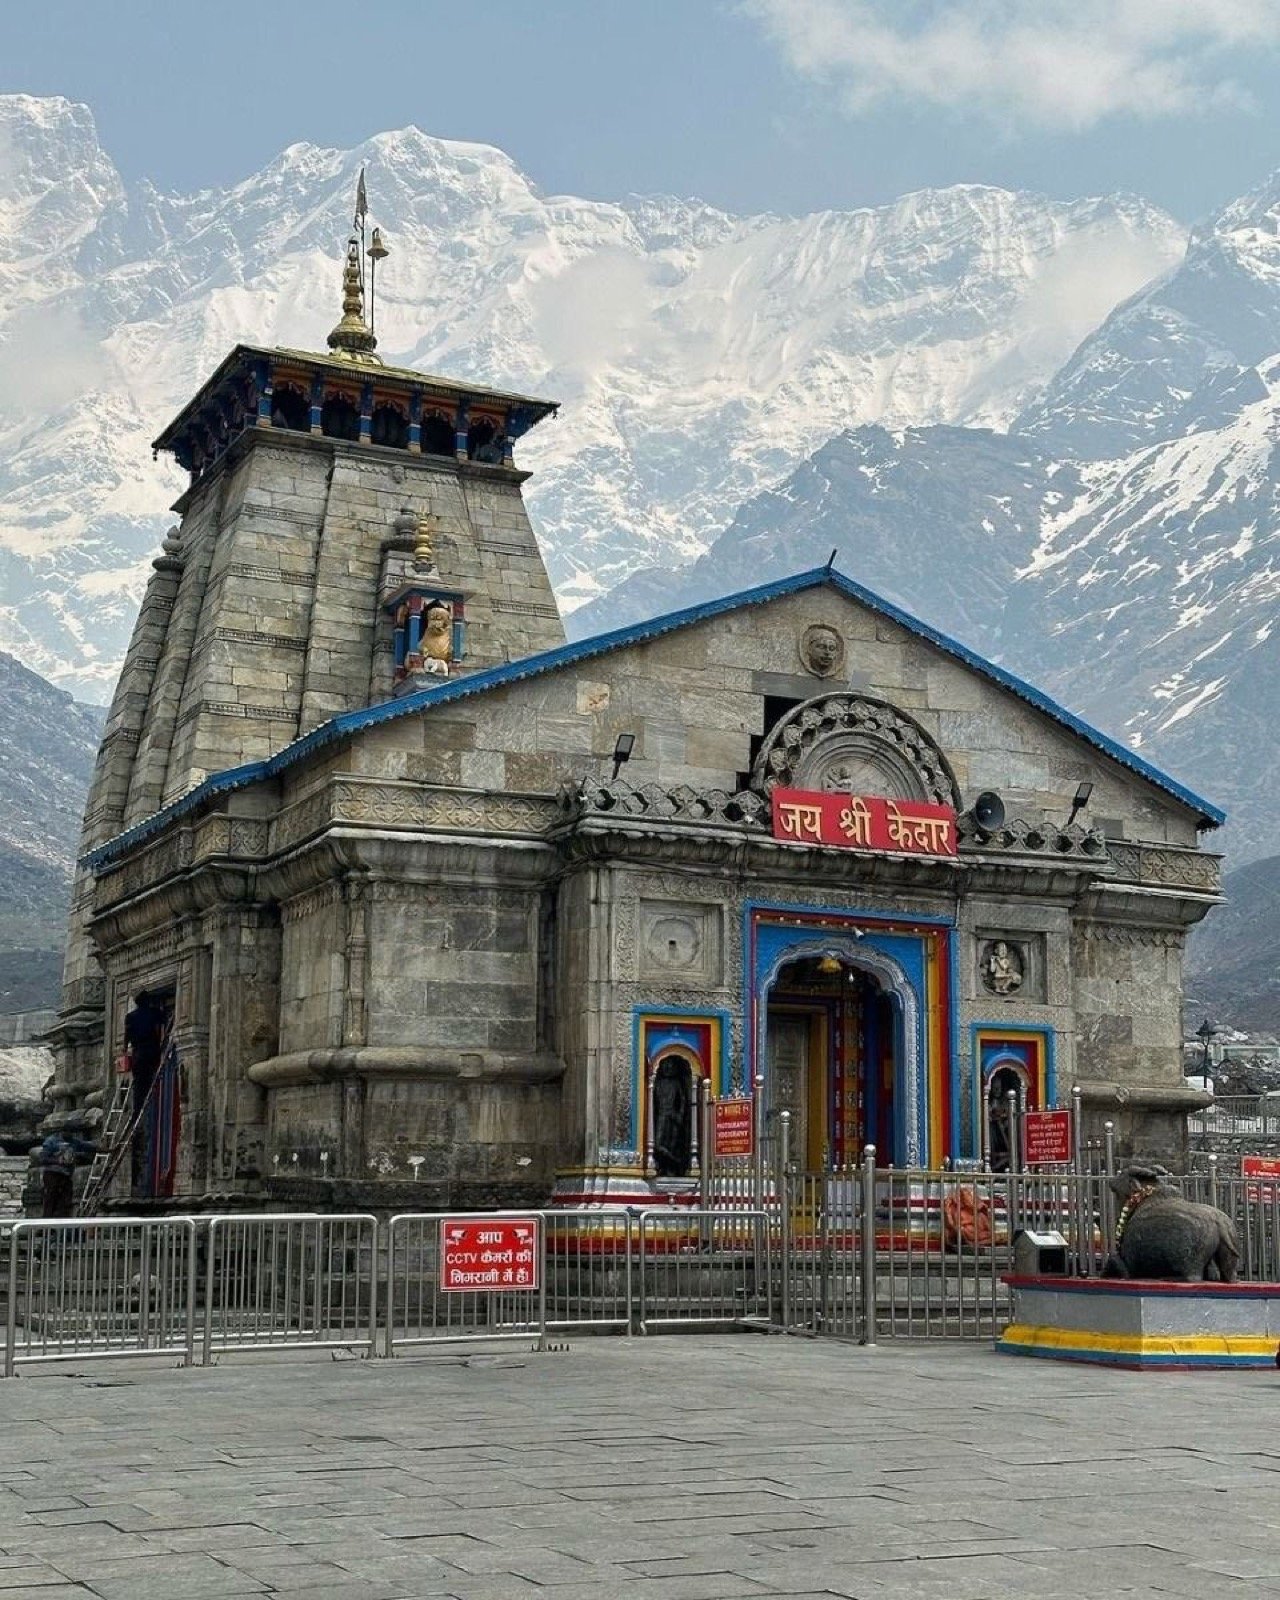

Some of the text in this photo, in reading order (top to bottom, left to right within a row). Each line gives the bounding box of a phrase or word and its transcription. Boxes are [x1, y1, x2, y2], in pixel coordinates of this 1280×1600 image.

[779, 796, 952, 854] जय श्री केदार
[476, 1231, 503, 1244] आप
[446, 1252, 477, 1264] CCTV
[515, 1248, 532, 1263] की
[450, 1268, 500, 1284] निगरानी
[503, 1267, 514, 1283] में
